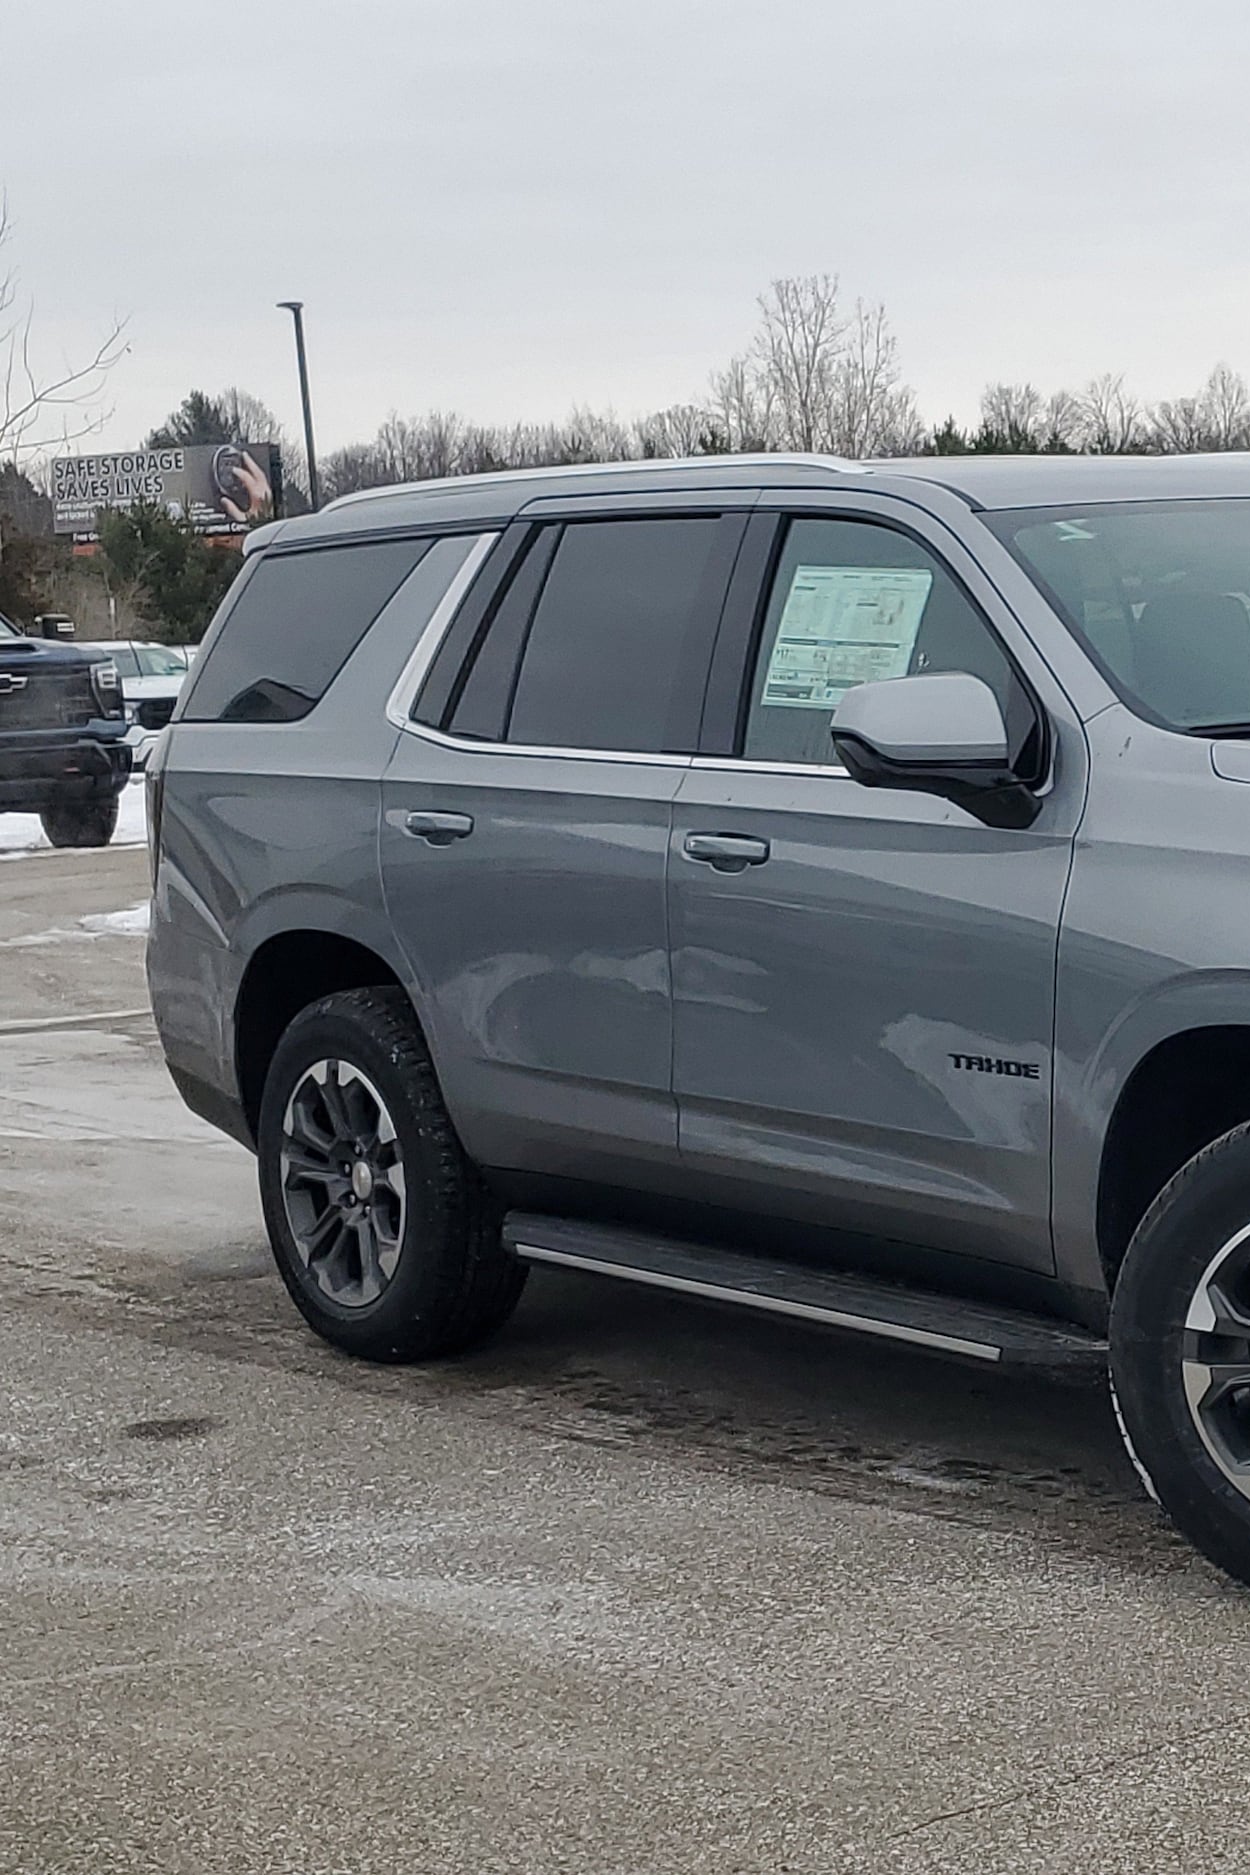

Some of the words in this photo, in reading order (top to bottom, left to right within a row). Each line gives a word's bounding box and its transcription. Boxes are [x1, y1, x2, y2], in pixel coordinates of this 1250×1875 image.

[54, 459, 96, 479] SAFE
[101, 452, 184, 475] STORAGE
[56, 479, 109, 500] SAVES
[116, 475, 163, 496] LIVES
[947, 1053, 1040, 1080] TAHOE
